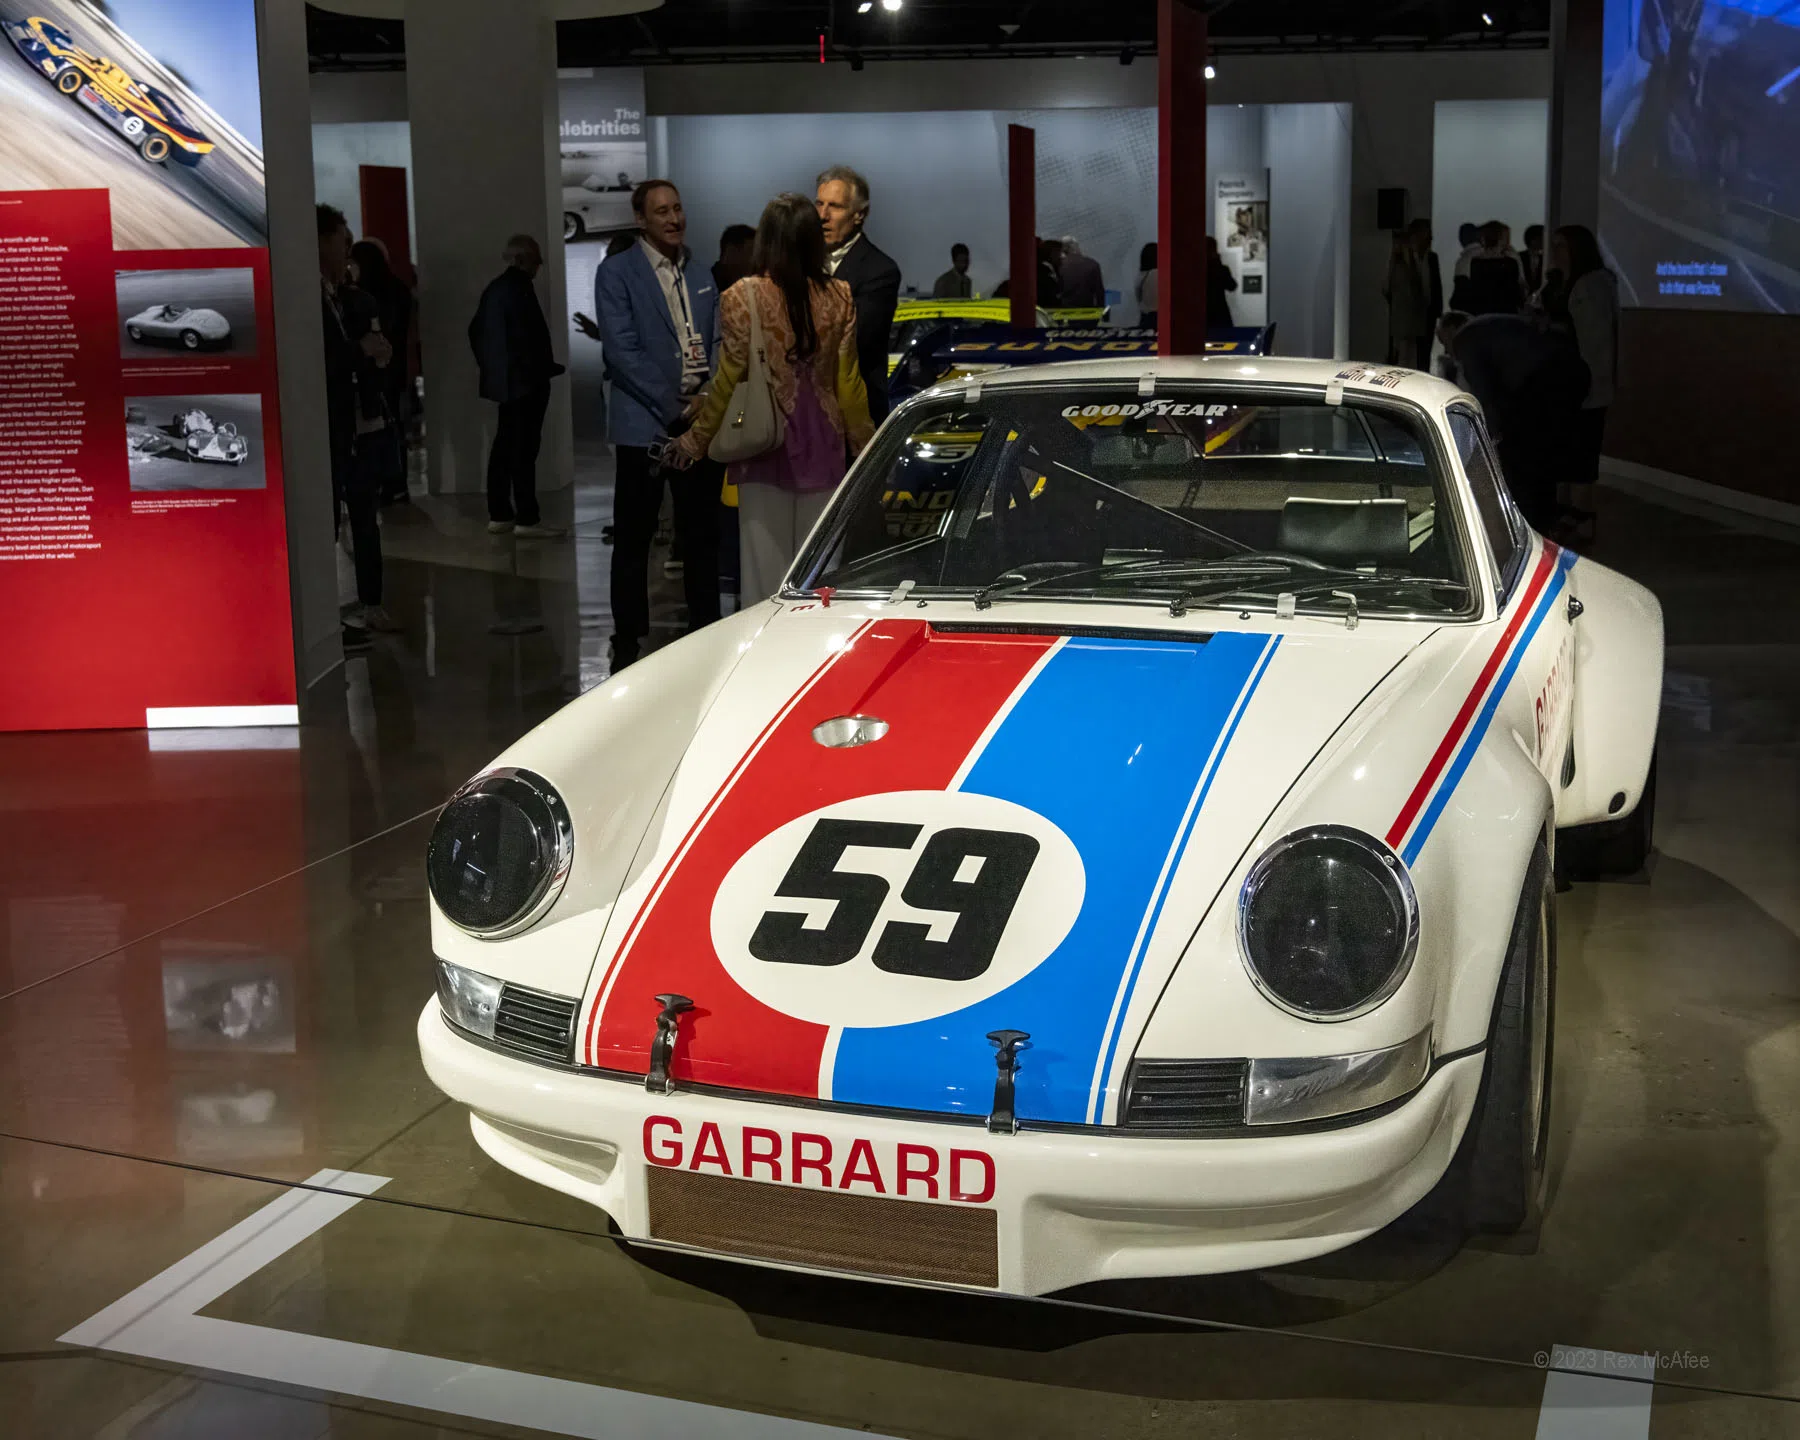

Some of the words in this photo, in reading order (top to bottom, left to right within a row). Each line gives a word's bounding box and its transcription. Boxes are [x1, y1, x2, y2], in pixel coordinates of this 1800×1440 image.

[614, 108, 640, 120] The
[1045, 329, 1158, 338] GOODYEA
[1061, 399, 1228, 418] GOODYEAR
[748, 818, 1041, 982] 59
[643, 1115, 997, 1203] GARRARD
